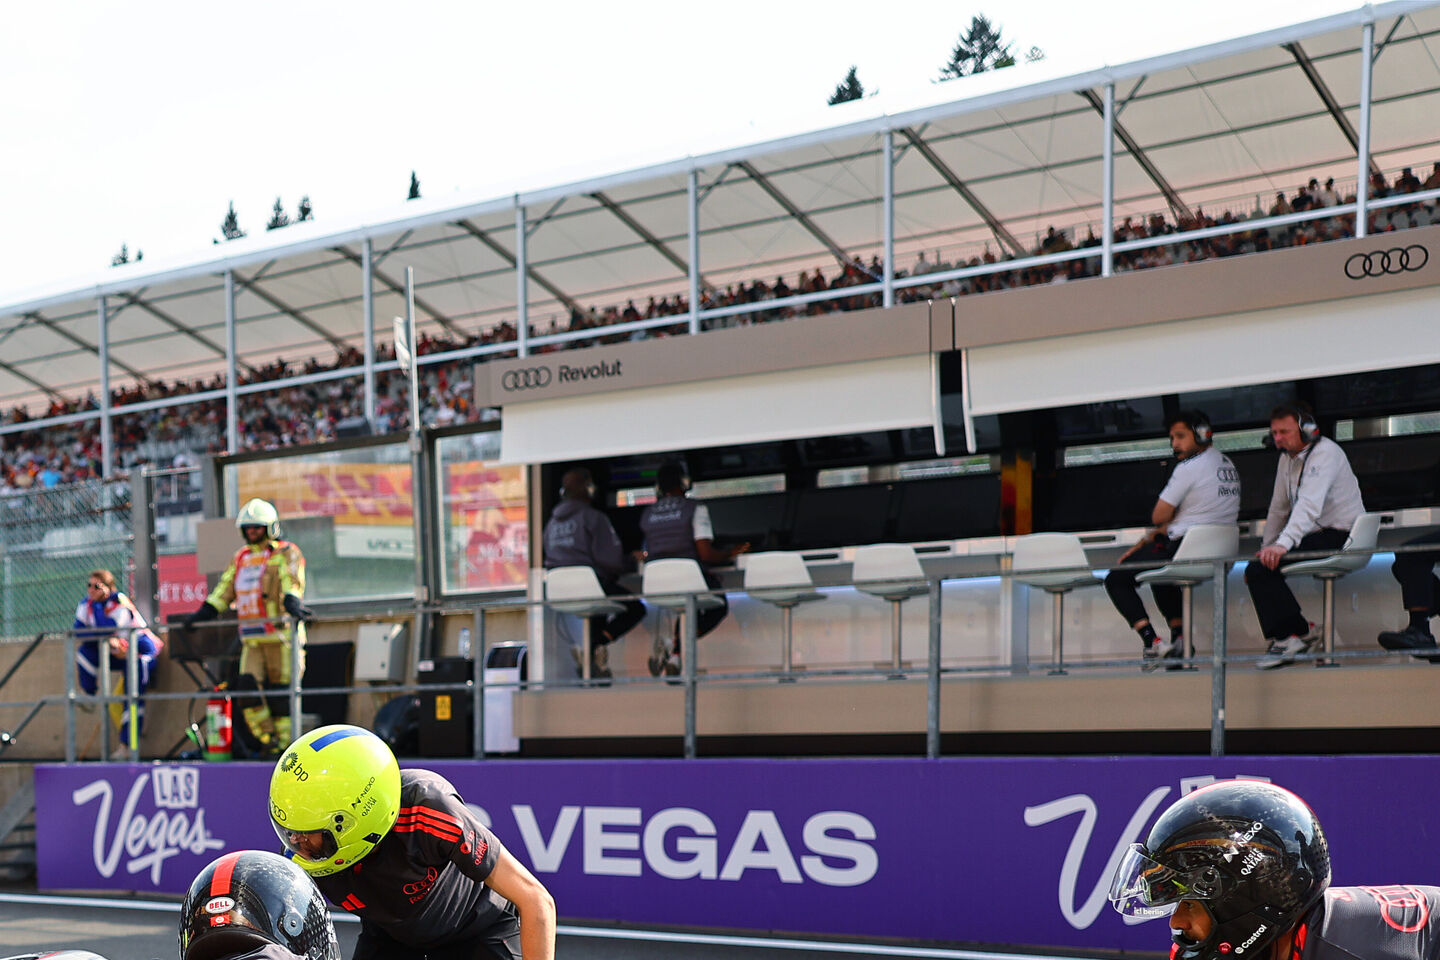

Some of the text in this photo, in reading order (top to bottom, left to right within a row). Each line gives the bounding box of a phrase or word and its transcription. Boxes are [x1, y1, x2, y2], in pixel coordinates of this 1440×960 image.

[559, 359, 623, 385] Revolut
[293, 763, 309, 782] bp
[153, 768, 198, 806] LAS
[360, 776, 376, 799] NEXO
[73, 773, 225, 885] Vegas
[1238, 821, 1263, 847] NEXO
[513, 806, 878, 887] VEGAS
[1241, 847, 1261, 865] visit
[1240, 853, 1266, 876] QATAR
[209, 901, 230, 910] BELL
[1241, 924, 1267, 949] Castrol
